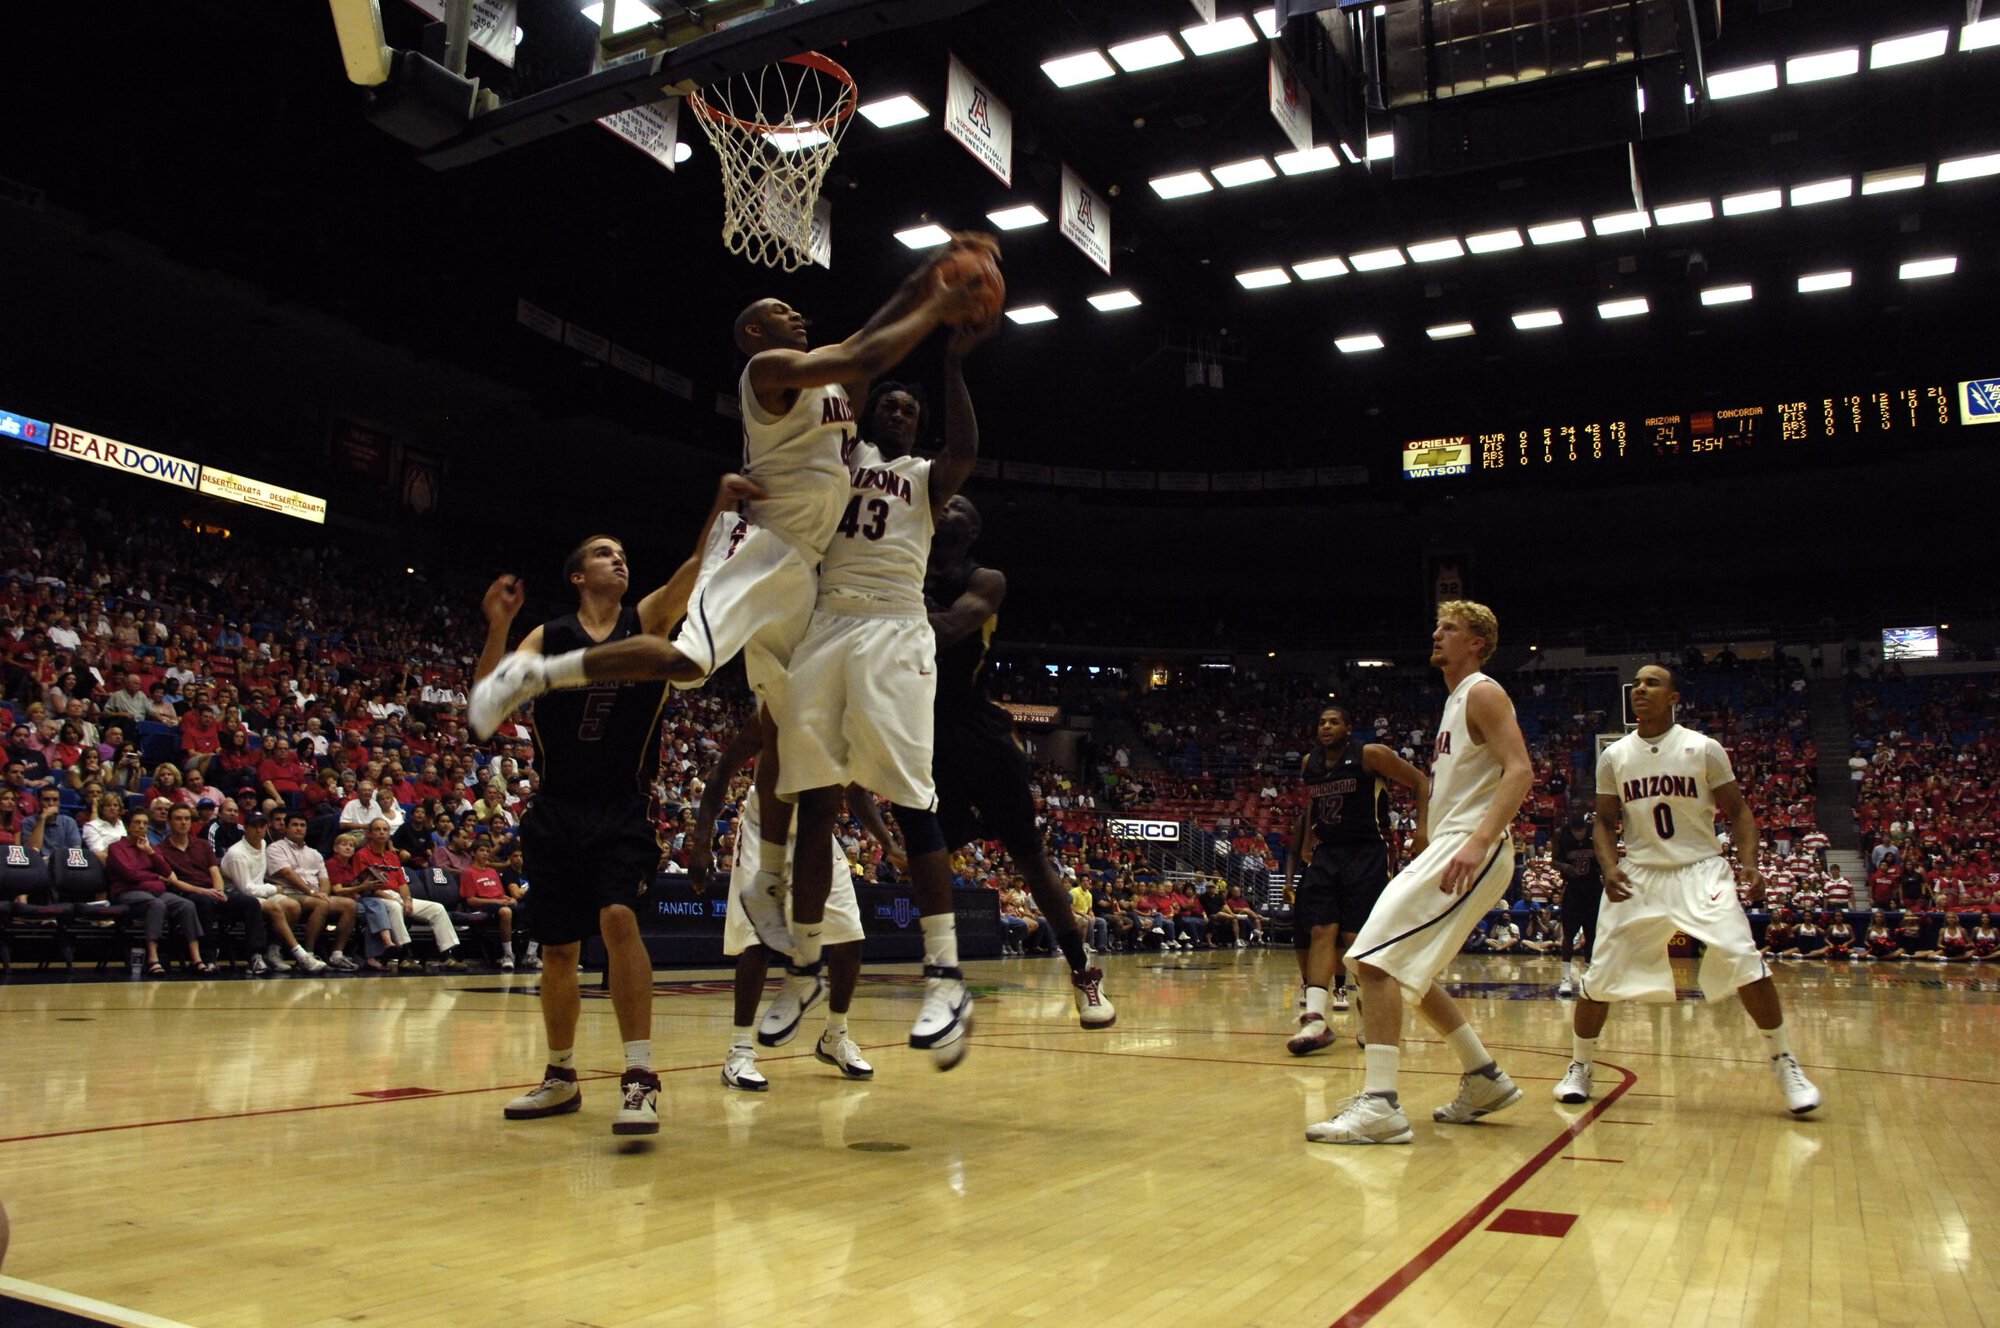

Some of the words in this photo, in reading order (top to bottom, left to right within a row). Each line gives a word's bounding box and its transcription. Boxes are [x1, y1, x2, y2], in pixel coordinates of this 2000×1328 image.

[965, 134, 983, 157] SWEET
[1777, 402, 1808, 413] PLYR
[1824, 398, 1833, 408] 5
[1872, 392, 1889, 403] 12
[1900, 389, 1917, 400] 15
[1927, 386, 1943, 397] 21
[1783, 411, 1804, 421] PTS
[1908, 399, 1918, 408] 0
[1937, 396, 1947, 405] 0
[1645, 415, 1681, 427] ARIZONA
[1717, 406, 1763, 419] CONCORDIA
[1782, 421, 1806, 431] RBS
[1825, 417, 1834, 426] 0
[1852, 415, 1861, 424] 2
[1938, 406, 1947, 415] 0
[1519, 431, 1527, 439] 0
[1543, 428, 1552, 436] 5
[1560, 426, 1575, 436] 34
[1584, 424, 1600, 433] 42
[1609, 421, 1626, 430] 43
[1656, 427, 1675, 441] 24
[1739, 418, 1753, 433] 11
[1783, 430, 1808, 440] FLS
[1825, 427, 1835, 436] 0
[1939, 415, 1948, 425] 0
[1408, 436, 1465, 450] O'RIELLY
[1482, 451, 1504, 460] RBS
[1593, 441, 1601, 450] 0
[1484, 442, 1502, 452] PTS
[1611, 431, 1626, 440] 10
[1692, 437, 1723, 452] 5:54
[1483, 460, 1504, 469] FLS
[1520, 456, 1528, 466] 0
[1544, 454, 1552, 463] 0
[1569, 452, 1577, 461] 0
[1594, 450, 1601, 459] 0
[1409, 465, 1466, 479] WATSON
[201, 473, 231, 488] DESERT
[232, 482, 261, 496] TOYOTA
[269, 492, 296, 506] DESERT
[297, 500, 325, 513] TOYOTA
[836, 495, 889, 541] 43
[1440, 581, 1459, 596] 32
[578, 692, 617, 741] 5
[1623, 774, 1698, 803] ARIZONA
[1318, 794, 1344, 825] 12
[1110, 823, 1178, 838] GEICO
[1653, 802, 1675, 840] 0
[6, 845, 30, 866] A
[67, 848, 89, 867] A
[658, 901, 704, 916] FANATICS
